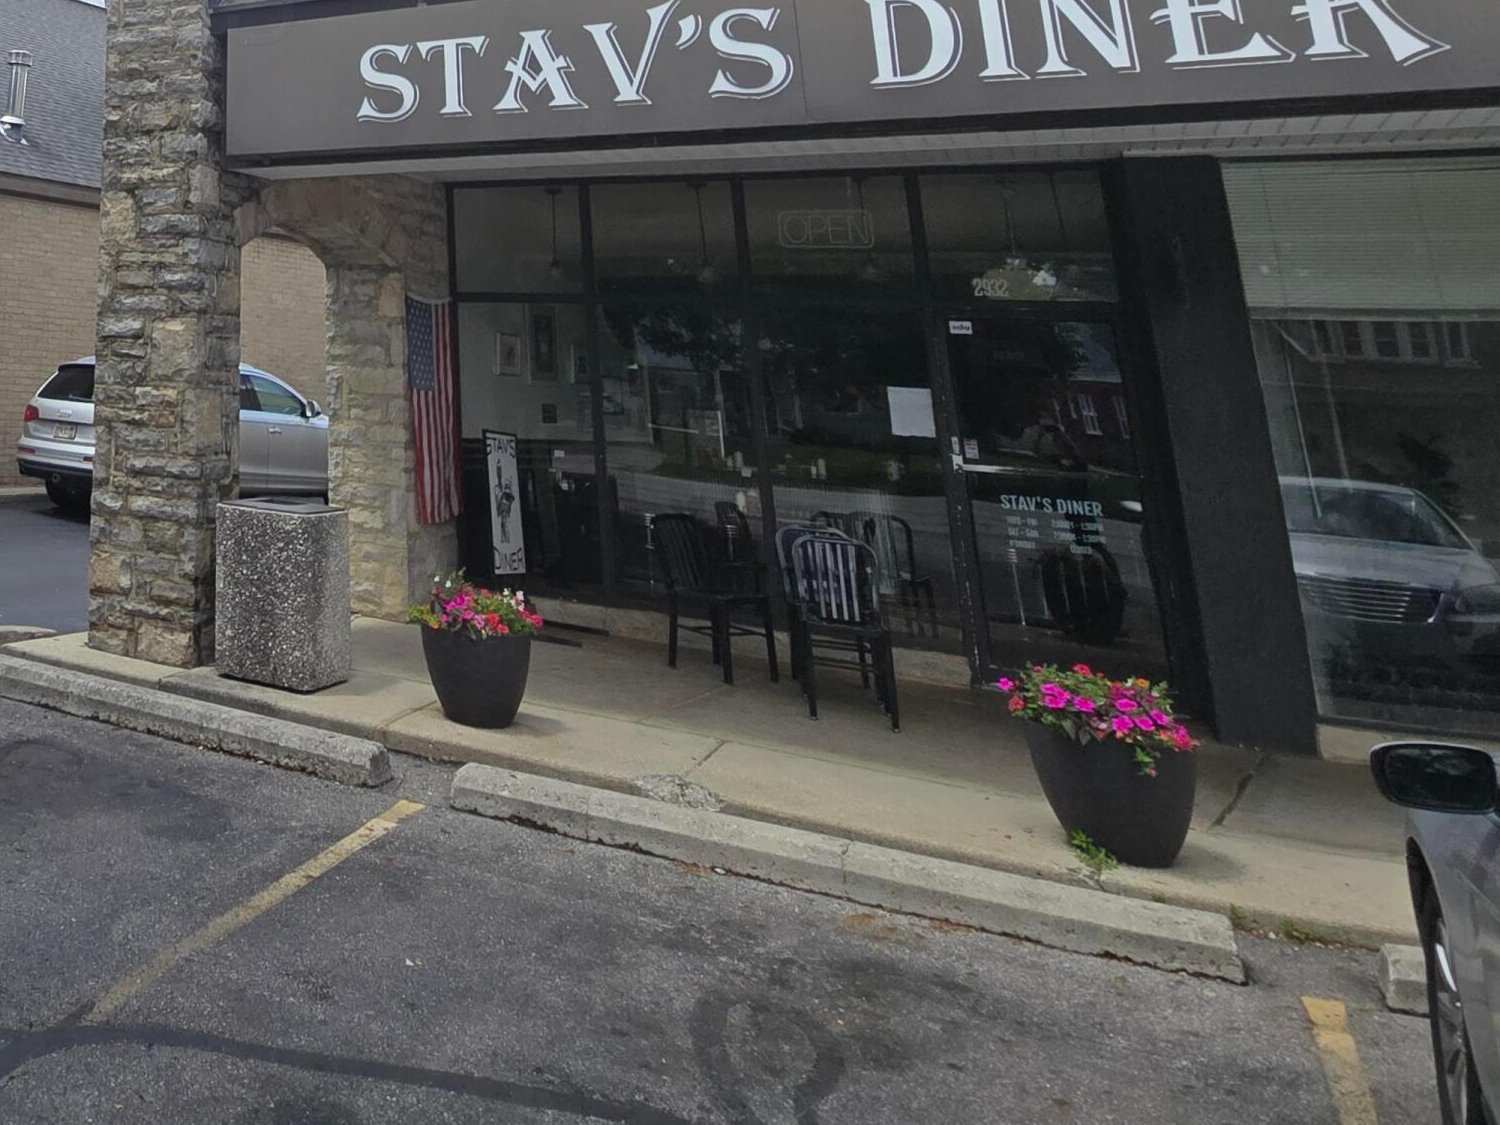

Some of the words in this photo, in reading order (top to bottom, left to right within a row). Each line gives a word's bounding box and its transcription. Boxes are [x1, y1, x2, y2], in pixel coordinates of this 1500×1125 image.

[783, 214, 869, 245] OPEN
[971, 277, 1009, 297] 2932
[999, 494, 1053, 513] STAV'S
[1056, 498, 1104, 517] DINER
